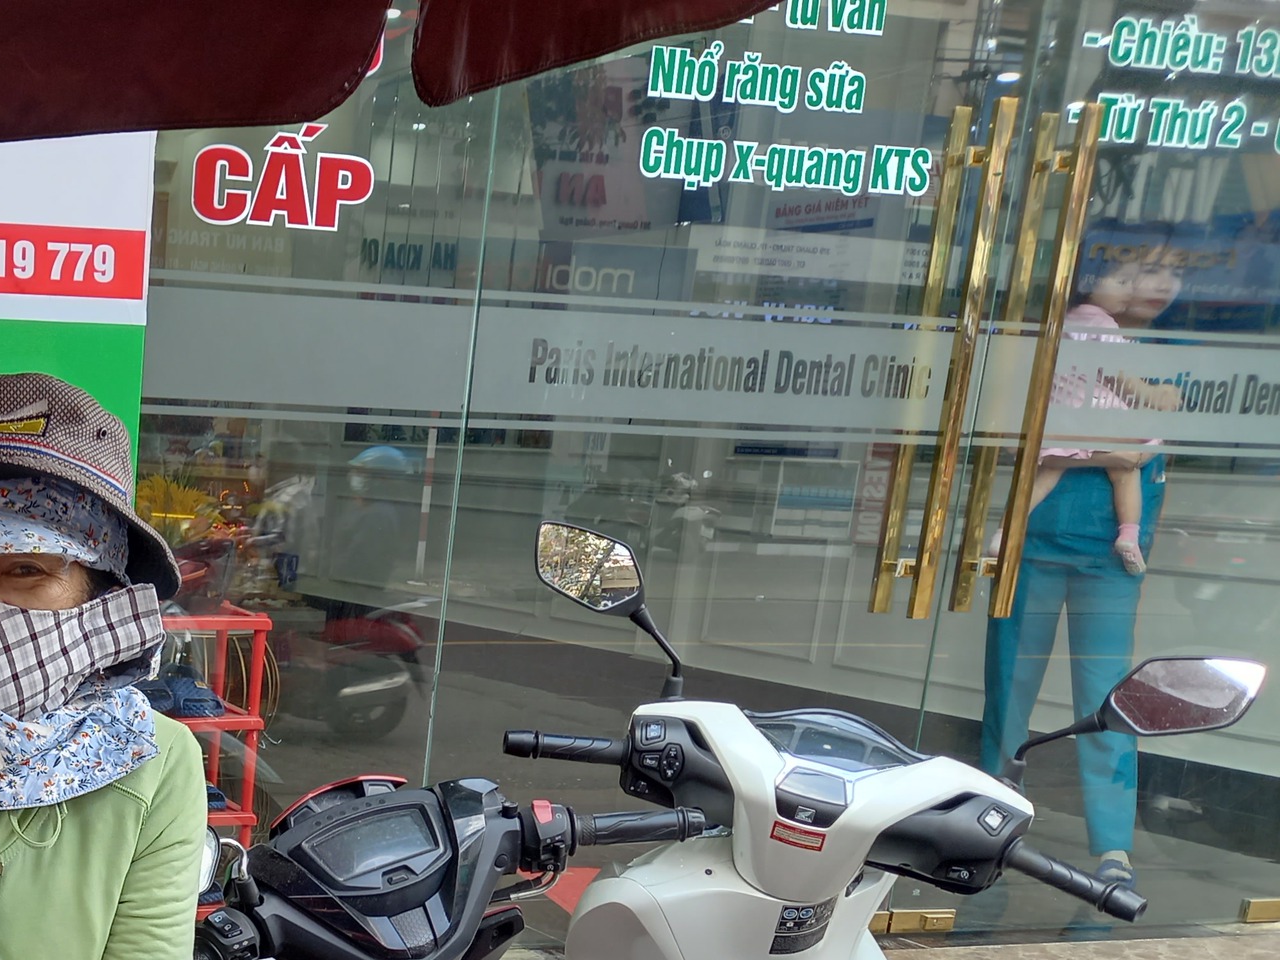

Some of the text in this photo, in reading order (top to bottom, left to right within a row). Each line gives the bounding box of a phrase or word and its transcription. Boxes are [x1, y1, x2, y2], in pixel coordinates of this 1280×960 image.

[1109, 13, 1227, 74] Chiều:
[648, 40, 866, 114] Nhổ răng sữa
[1097, 92, 1145, 144] Từ
[1148, 97, 1217, 149] Thứ
[1215, 100, 1247, 148] 2
[192, 123, 374, 231] CẤP
[640, 126, 726, 191] Chụp
[868, 144, 933, 196] KTS
[46, 241, 116, 283] 779
[528, 338, 932, 400] Paris International Dental Clinic
[1092, 366, 1238, 415] International
